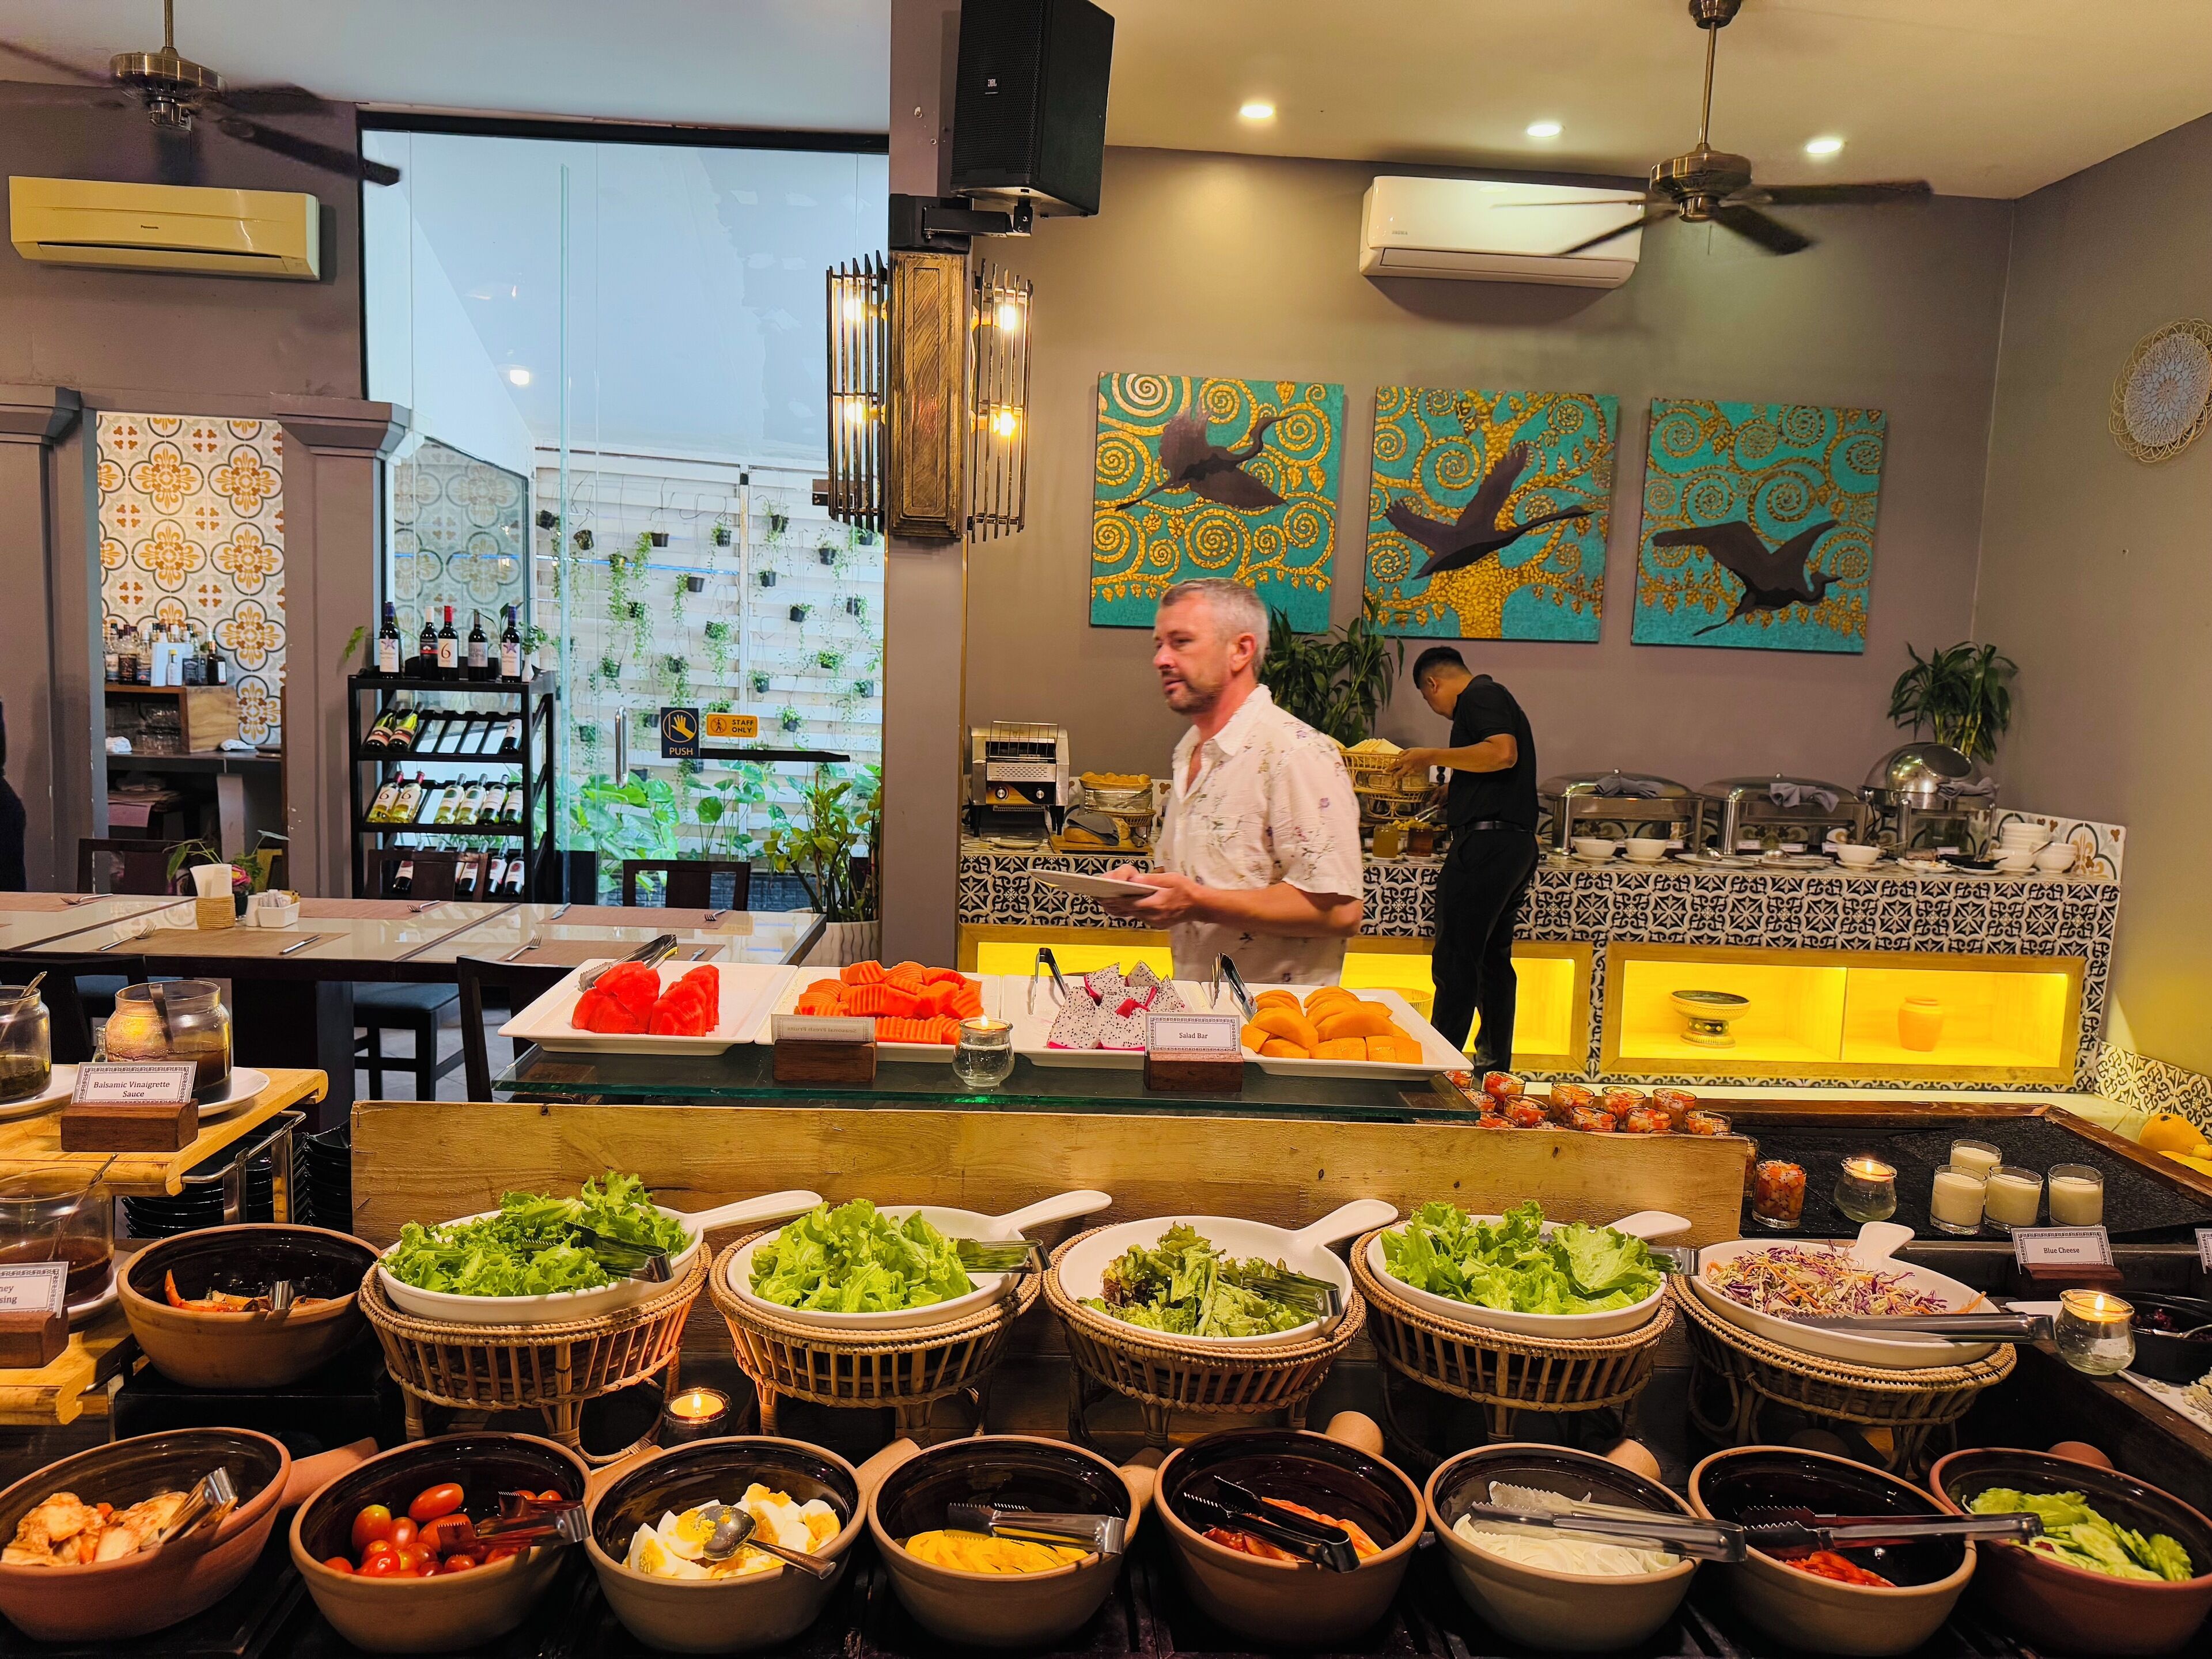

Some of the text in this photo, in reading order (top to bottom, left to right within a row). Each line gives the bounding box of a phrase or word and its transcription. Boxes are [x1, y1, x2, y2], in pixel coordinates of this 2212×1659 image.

[988, 78, 997, 87] JBL
[441, 643, 451, 659] 6
[669, 747, 694, 756] PUSH
[380, 789, 389, 800] 6
[402, 789, 411, 800] 6
[129, 1081, 171, 1089] Vinaigrette
